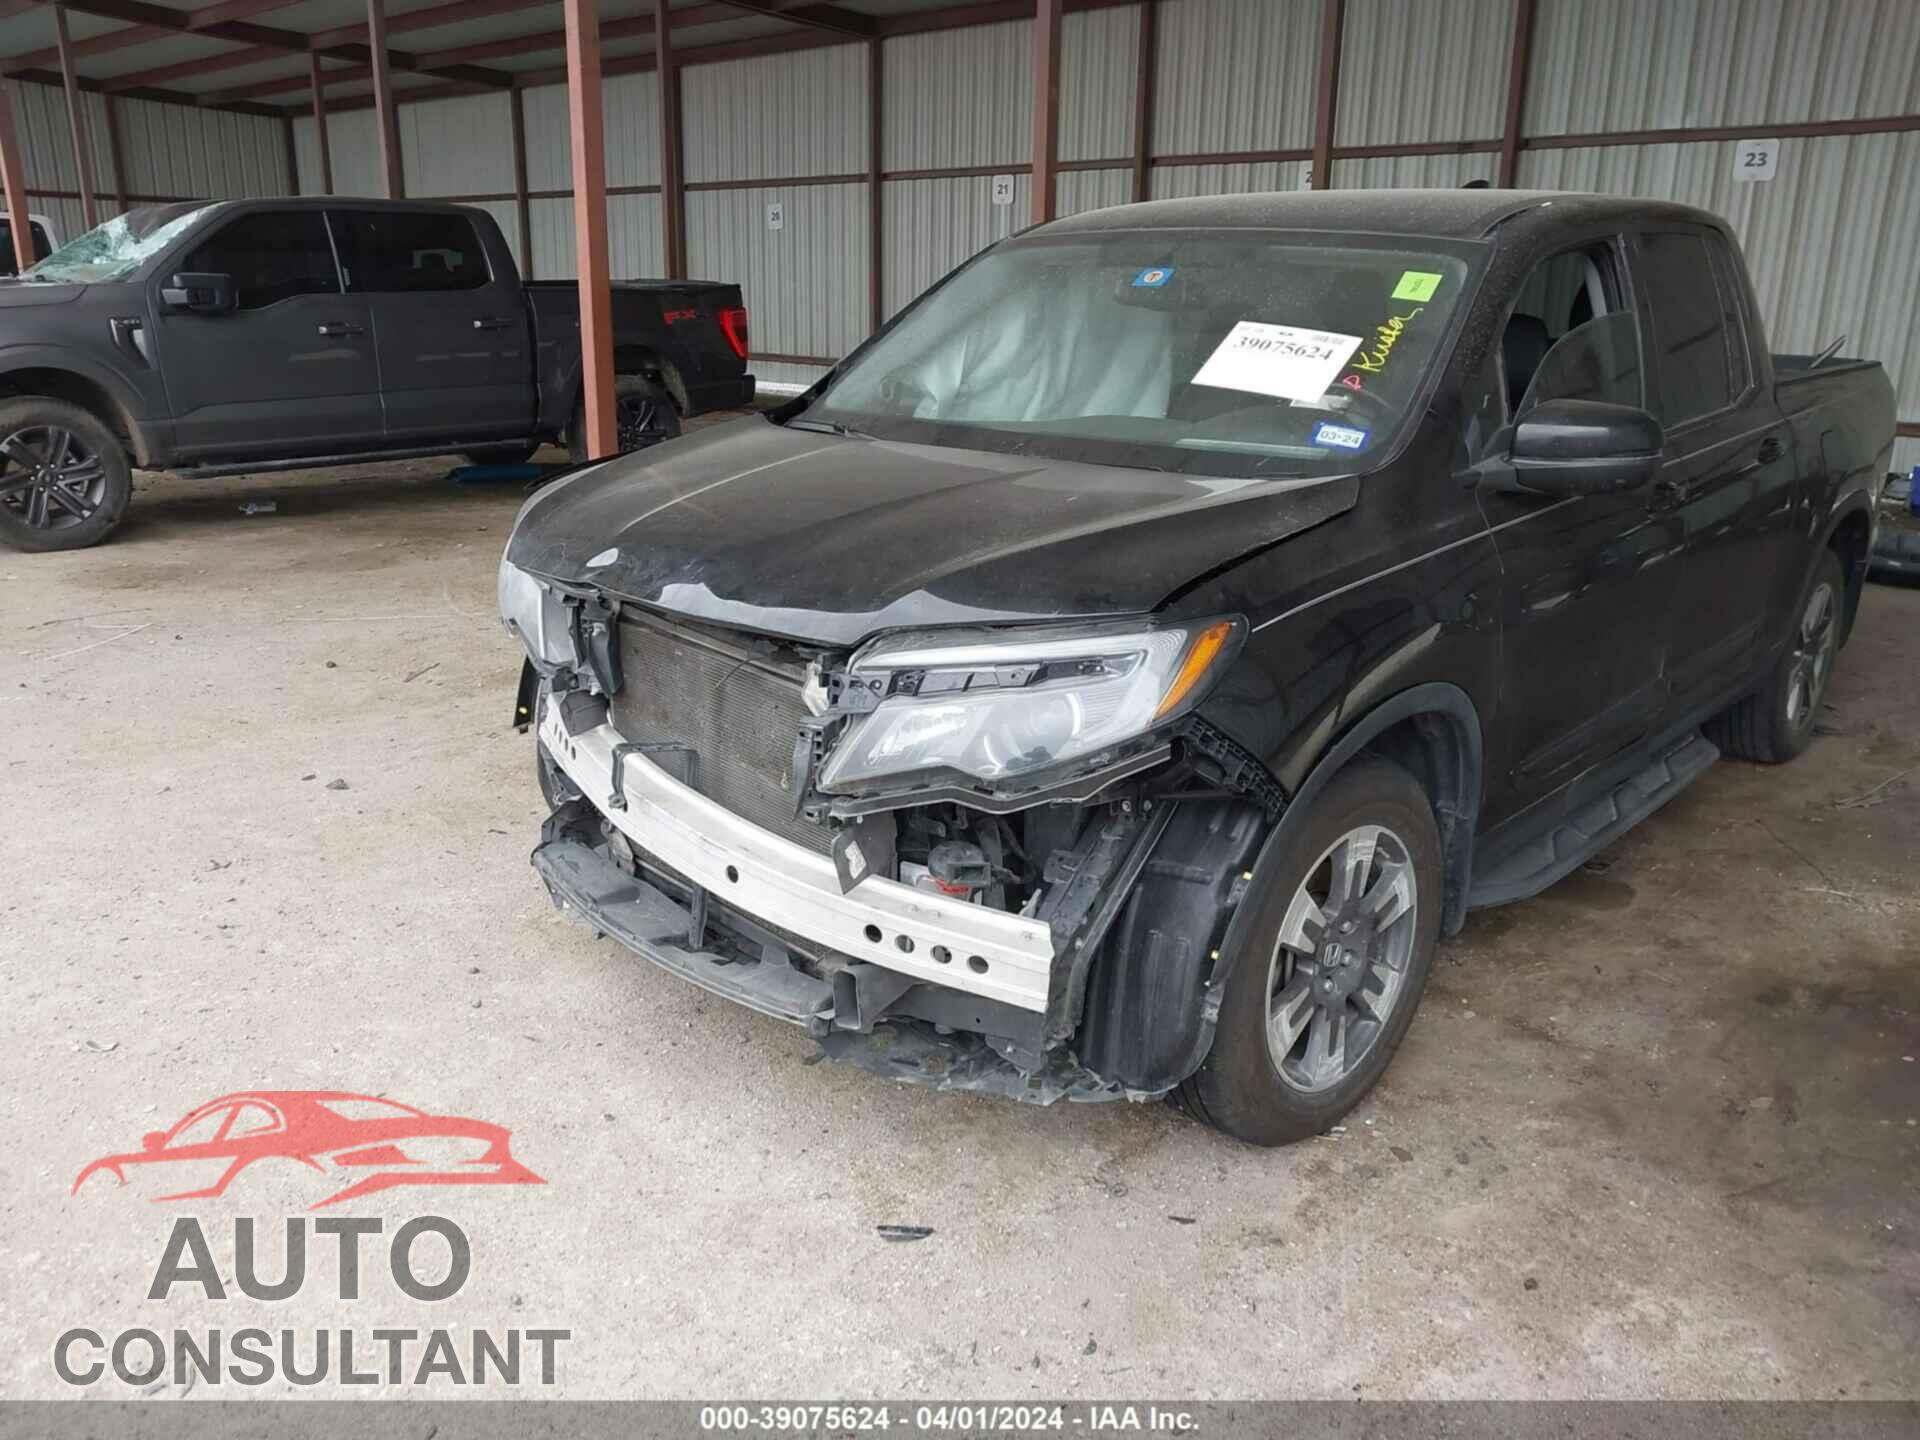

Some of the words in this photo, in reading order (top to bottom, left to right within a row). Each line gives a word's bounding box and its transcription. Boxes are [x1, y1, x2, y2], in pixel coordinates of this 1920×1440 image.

[1744, 152, 1768, 167] 23
[997, 183, 1009, 195] 21
[1232, 335, 1335, 361] 39075624
[1320, 430, 1361, 446] 03-24
